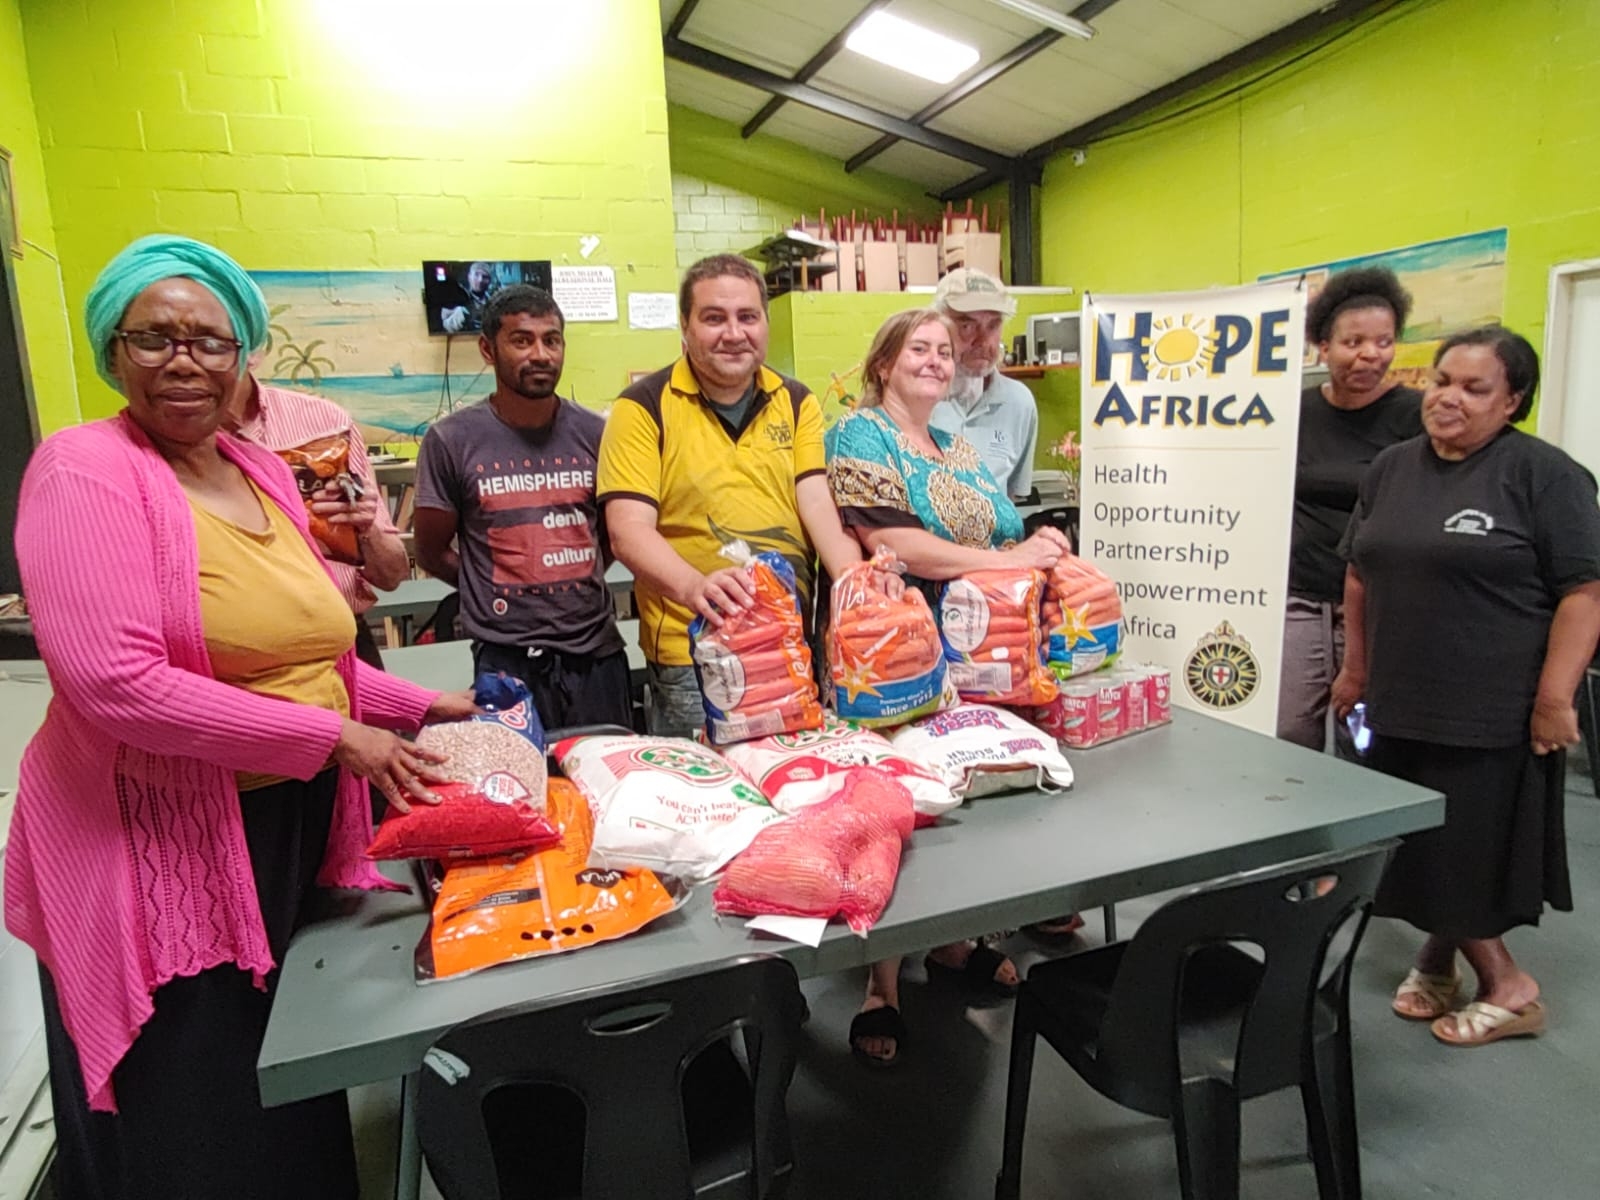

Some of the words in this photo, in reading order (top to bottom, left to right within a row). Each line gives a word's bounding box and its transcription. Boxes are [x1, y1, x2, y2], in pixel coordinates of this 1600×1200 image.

[1092, 308, 1290, 386] HOPE
[1093, 382, 1275, 427] AFRICA
[475, 457, 592, 473] ORIGINAL
[1094, 462, 1168, 485] Health
[477, 470, 594, 496] HEMISPHERE
[1093, 501, 1241, 532] Opportunity
[542, 547, 597, 568] cultur
[1093, 539, 1230, 570] Partnership
[1115, 581, 1268, 607] powerment
[656, 794, 680, 810] You
[681, 803, 708, 815] can't
